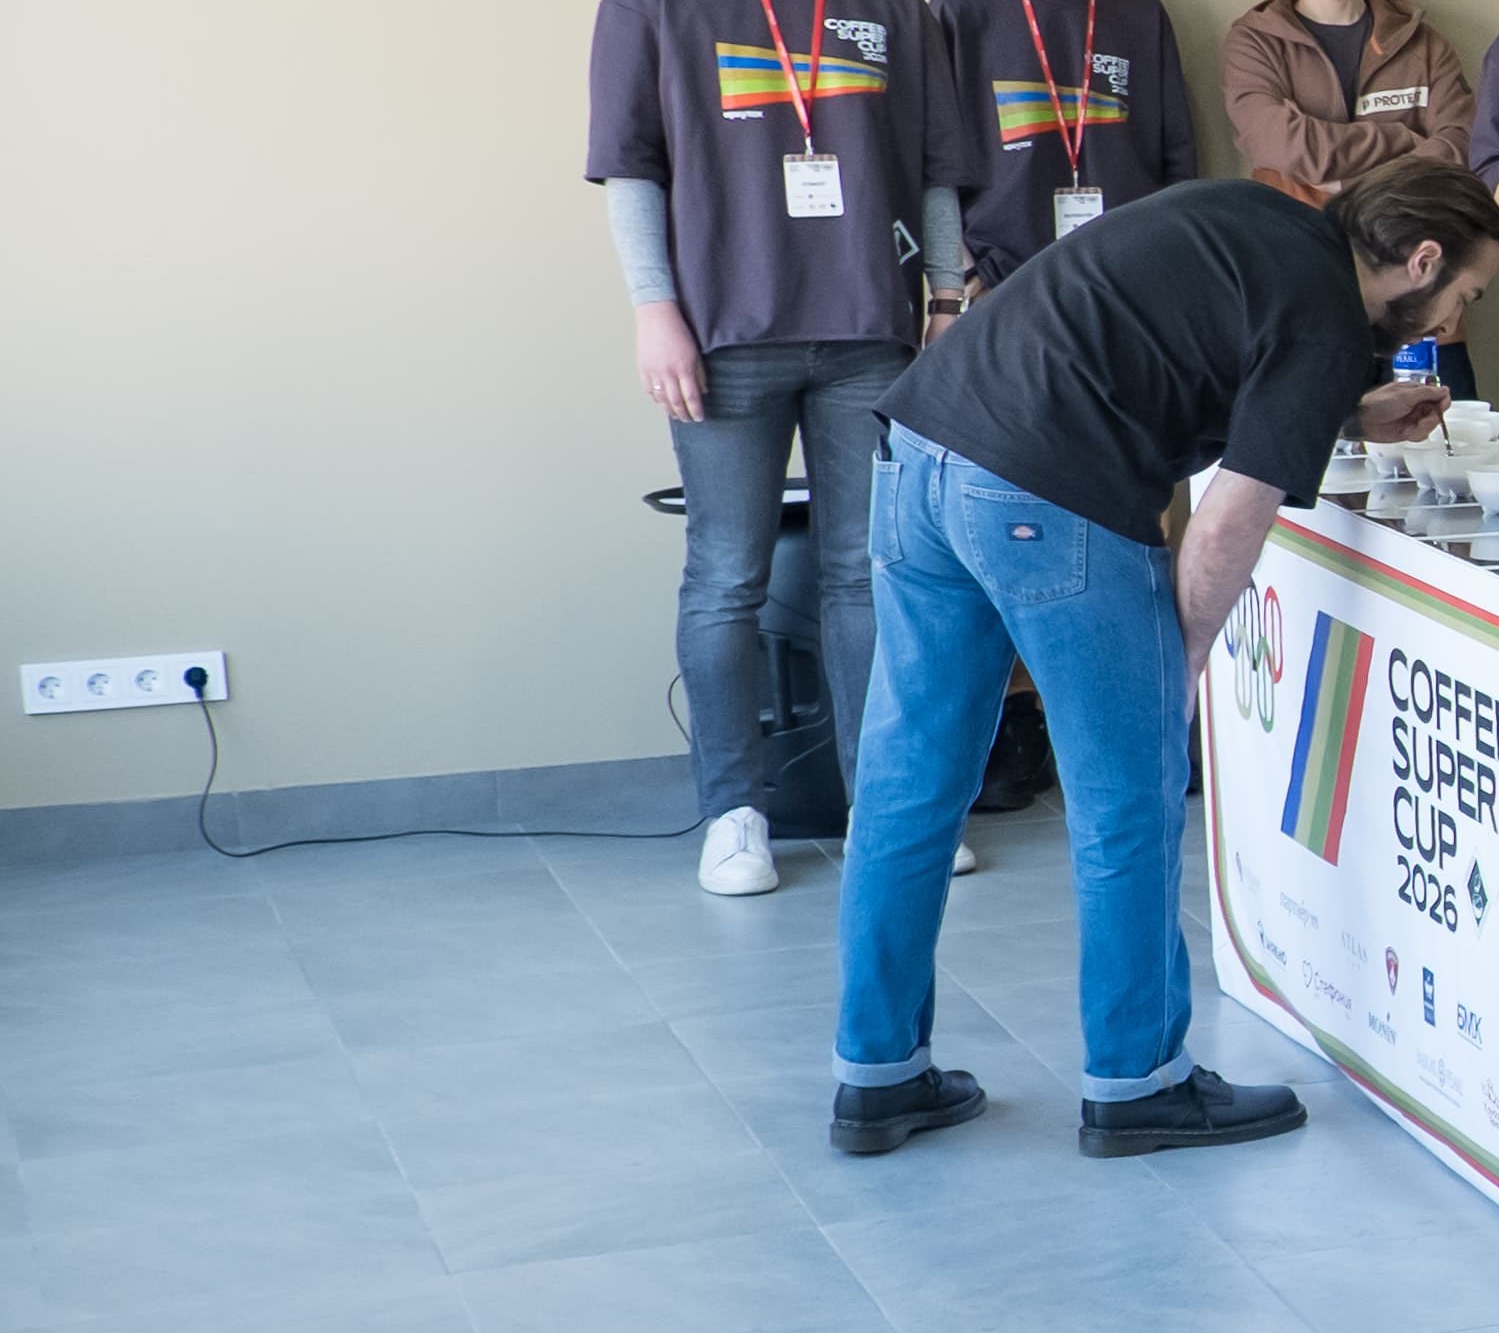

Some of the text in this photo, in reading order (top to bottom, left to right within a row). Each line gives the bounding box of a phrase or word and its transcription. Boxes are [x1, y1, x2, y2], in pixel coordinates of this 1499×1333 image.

[1392, 716, 1498, 834] SUPER
[1393, 786, 1457, 870] CUP
[1397, 855, 1457, 933] 2026
